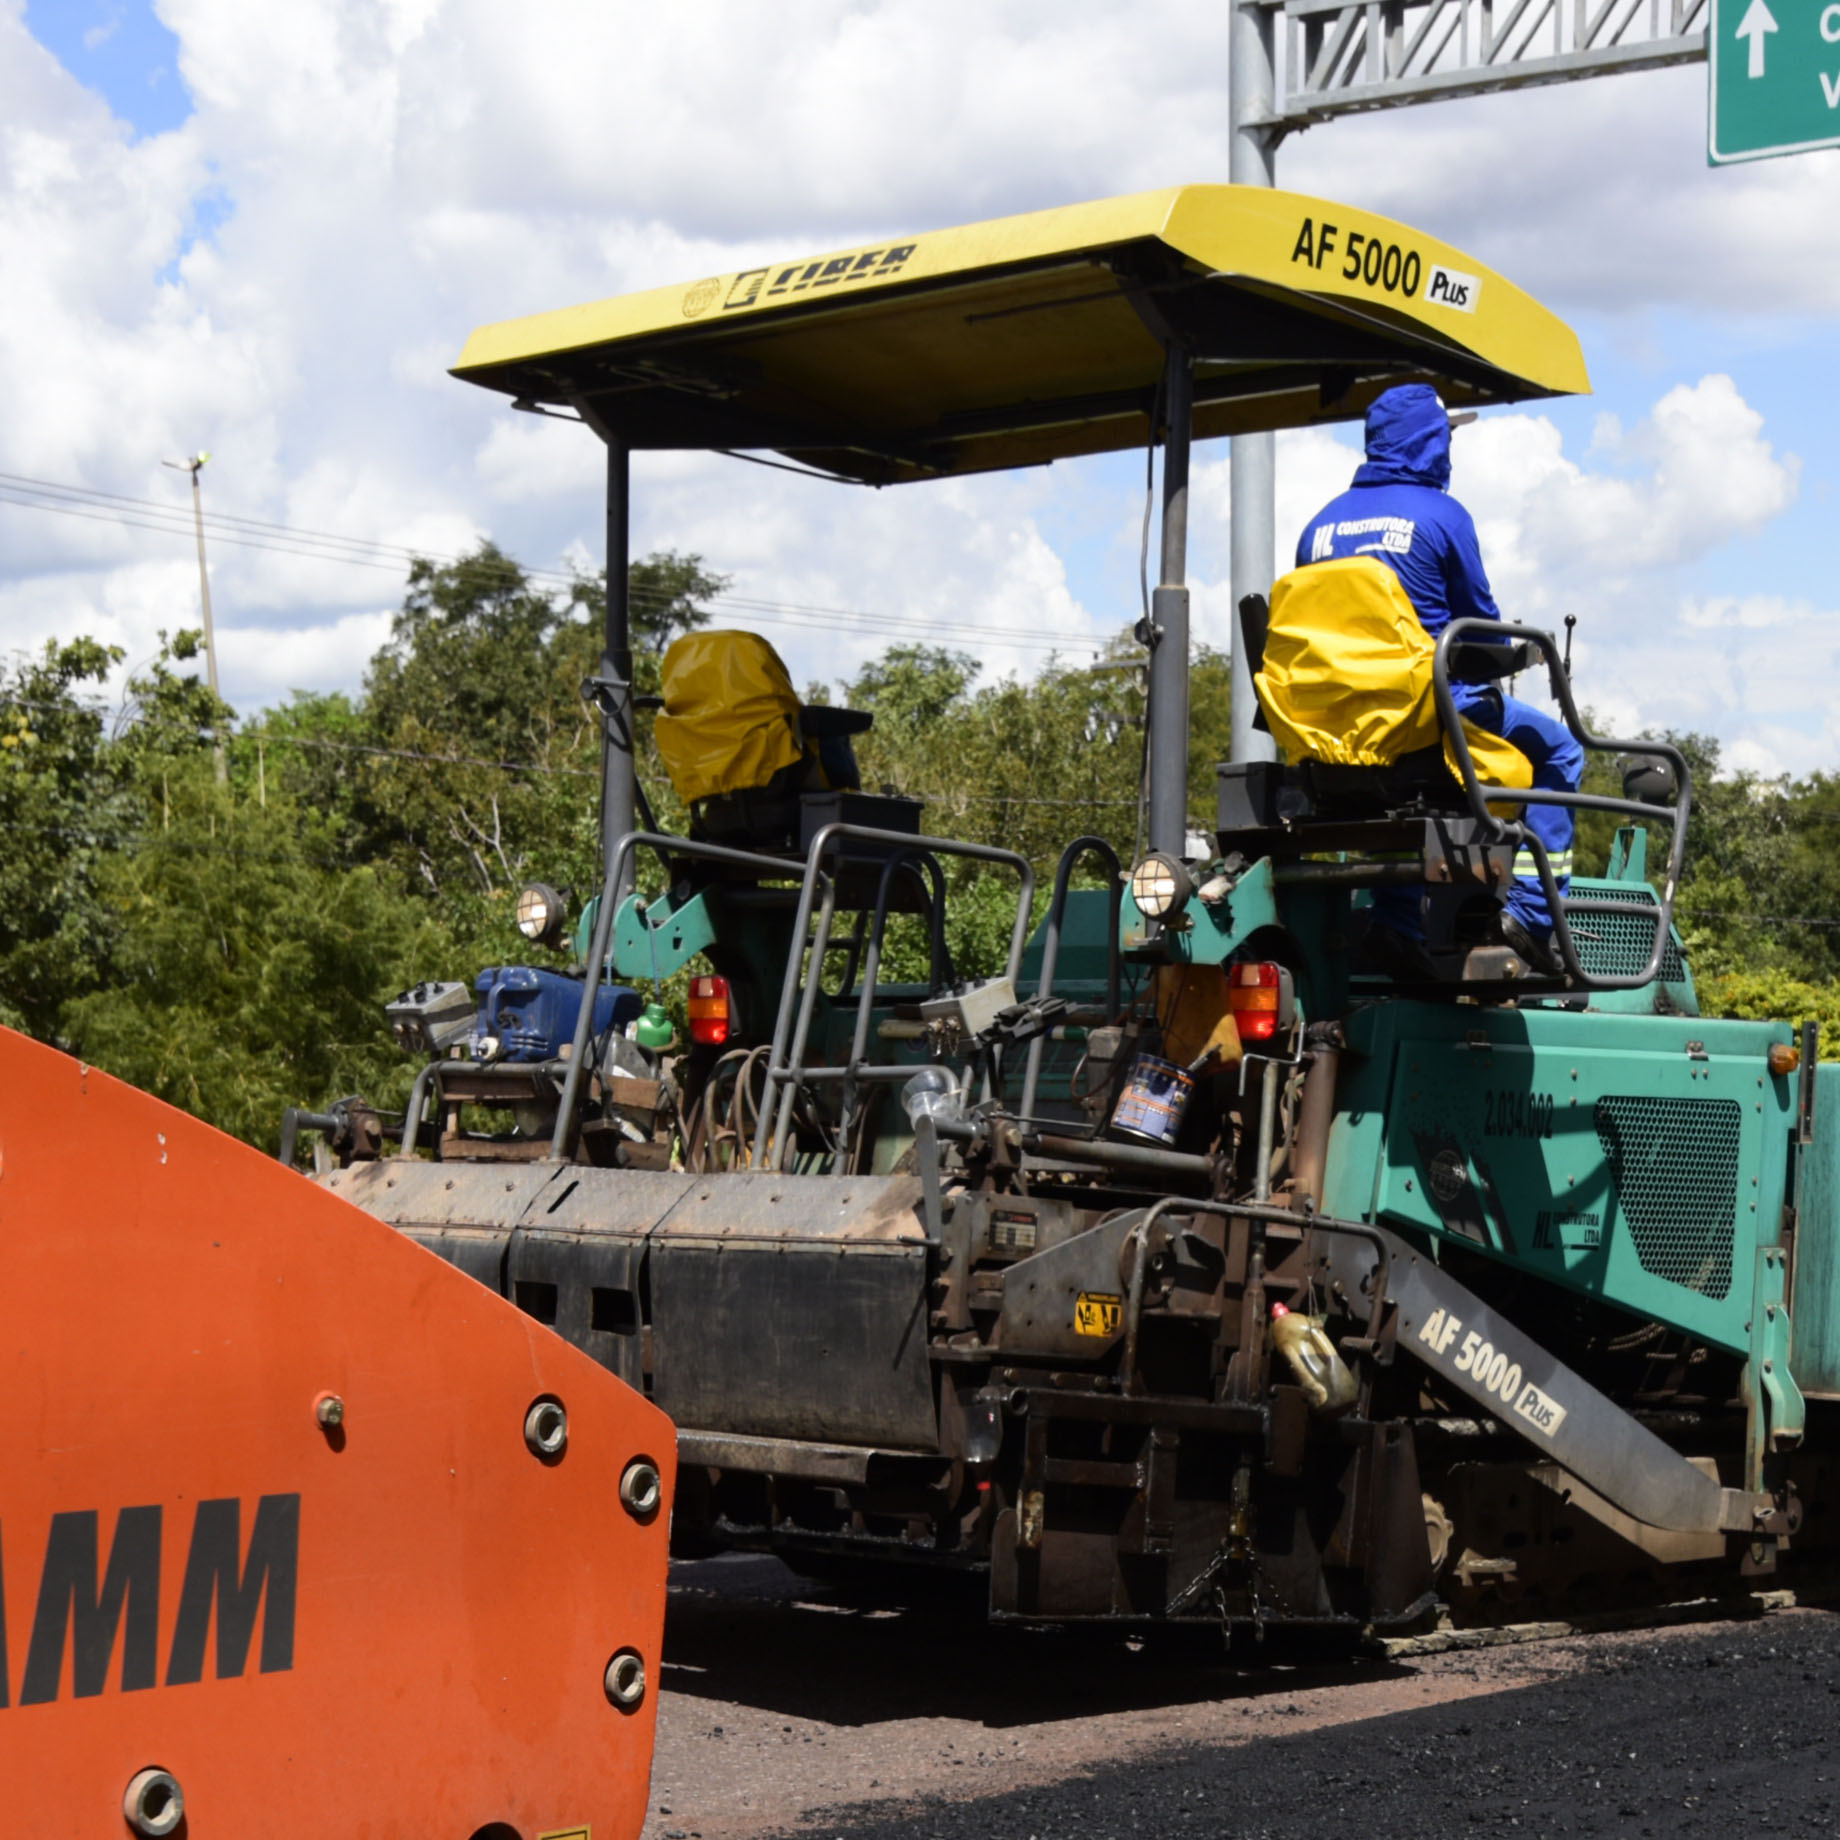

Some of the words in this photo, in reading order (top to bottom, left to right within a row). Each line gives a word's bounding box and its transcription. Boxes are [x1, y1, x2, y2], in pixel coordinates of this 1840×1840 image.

[1291, 217, 1338, 270] AF
[1342, 231, 1421, 297] 5000
[1337, 516, 1415, 535] CONSTRUTORA
[1382, 531, 1411, 550] LTDA
[1418, 1308, 1462, 1355] AF
[1454, 1331, 1522, 1403] 5000
